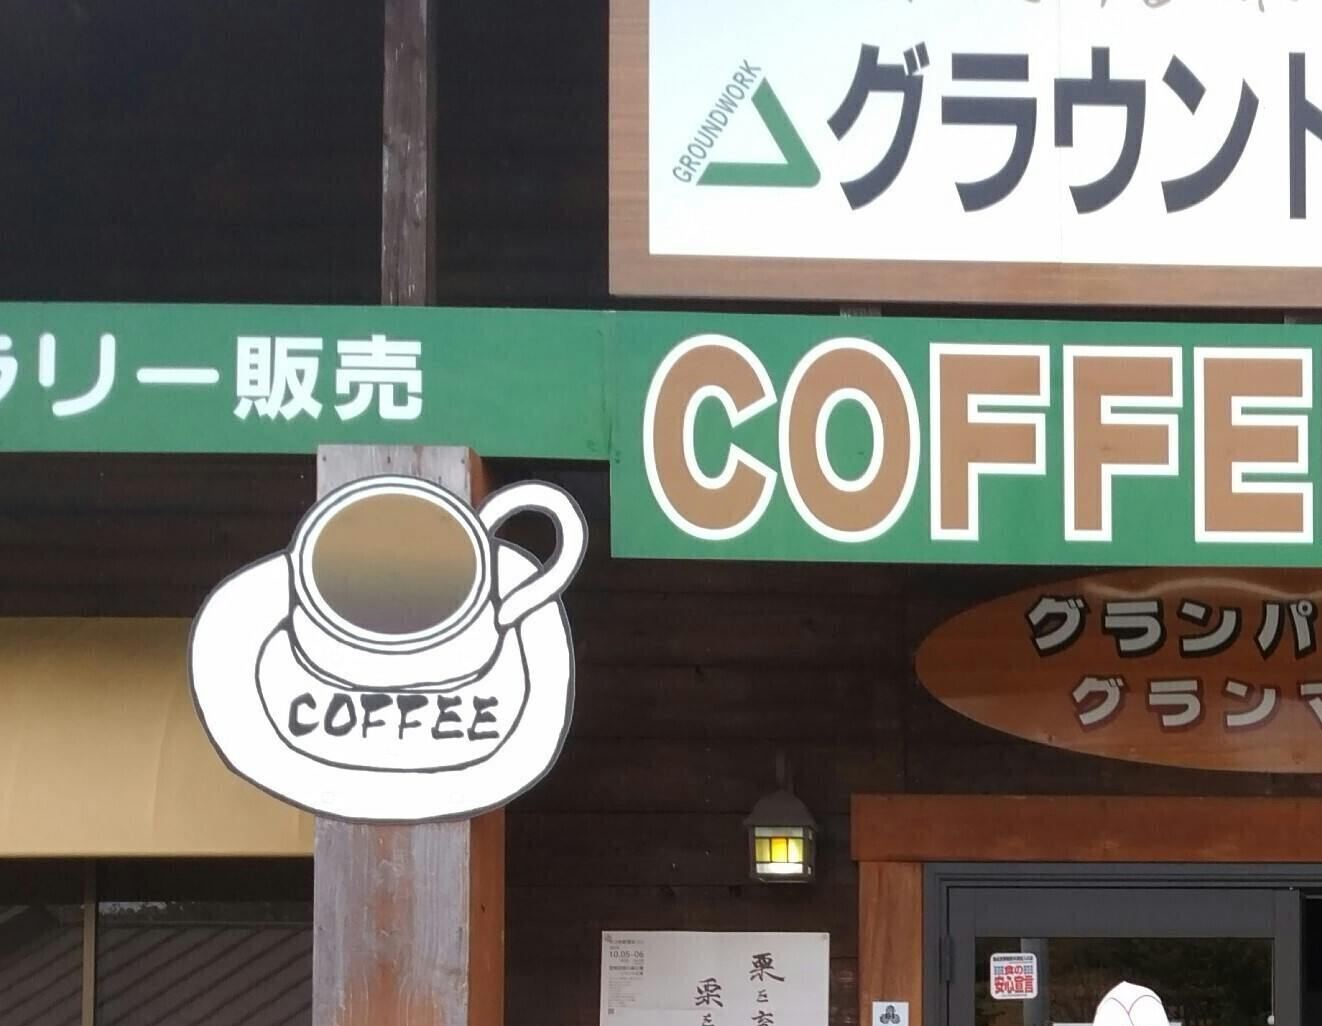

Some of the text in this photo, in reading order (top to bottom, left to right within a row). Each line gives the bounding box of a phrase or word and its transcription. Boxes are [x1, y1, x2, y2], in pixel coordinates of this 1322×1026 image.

[672, 59, 762, 184] GROUNDWORK
[288, 692, 501, 742] COFFEE
[994, 975, 1034, 994] 安心宣言
